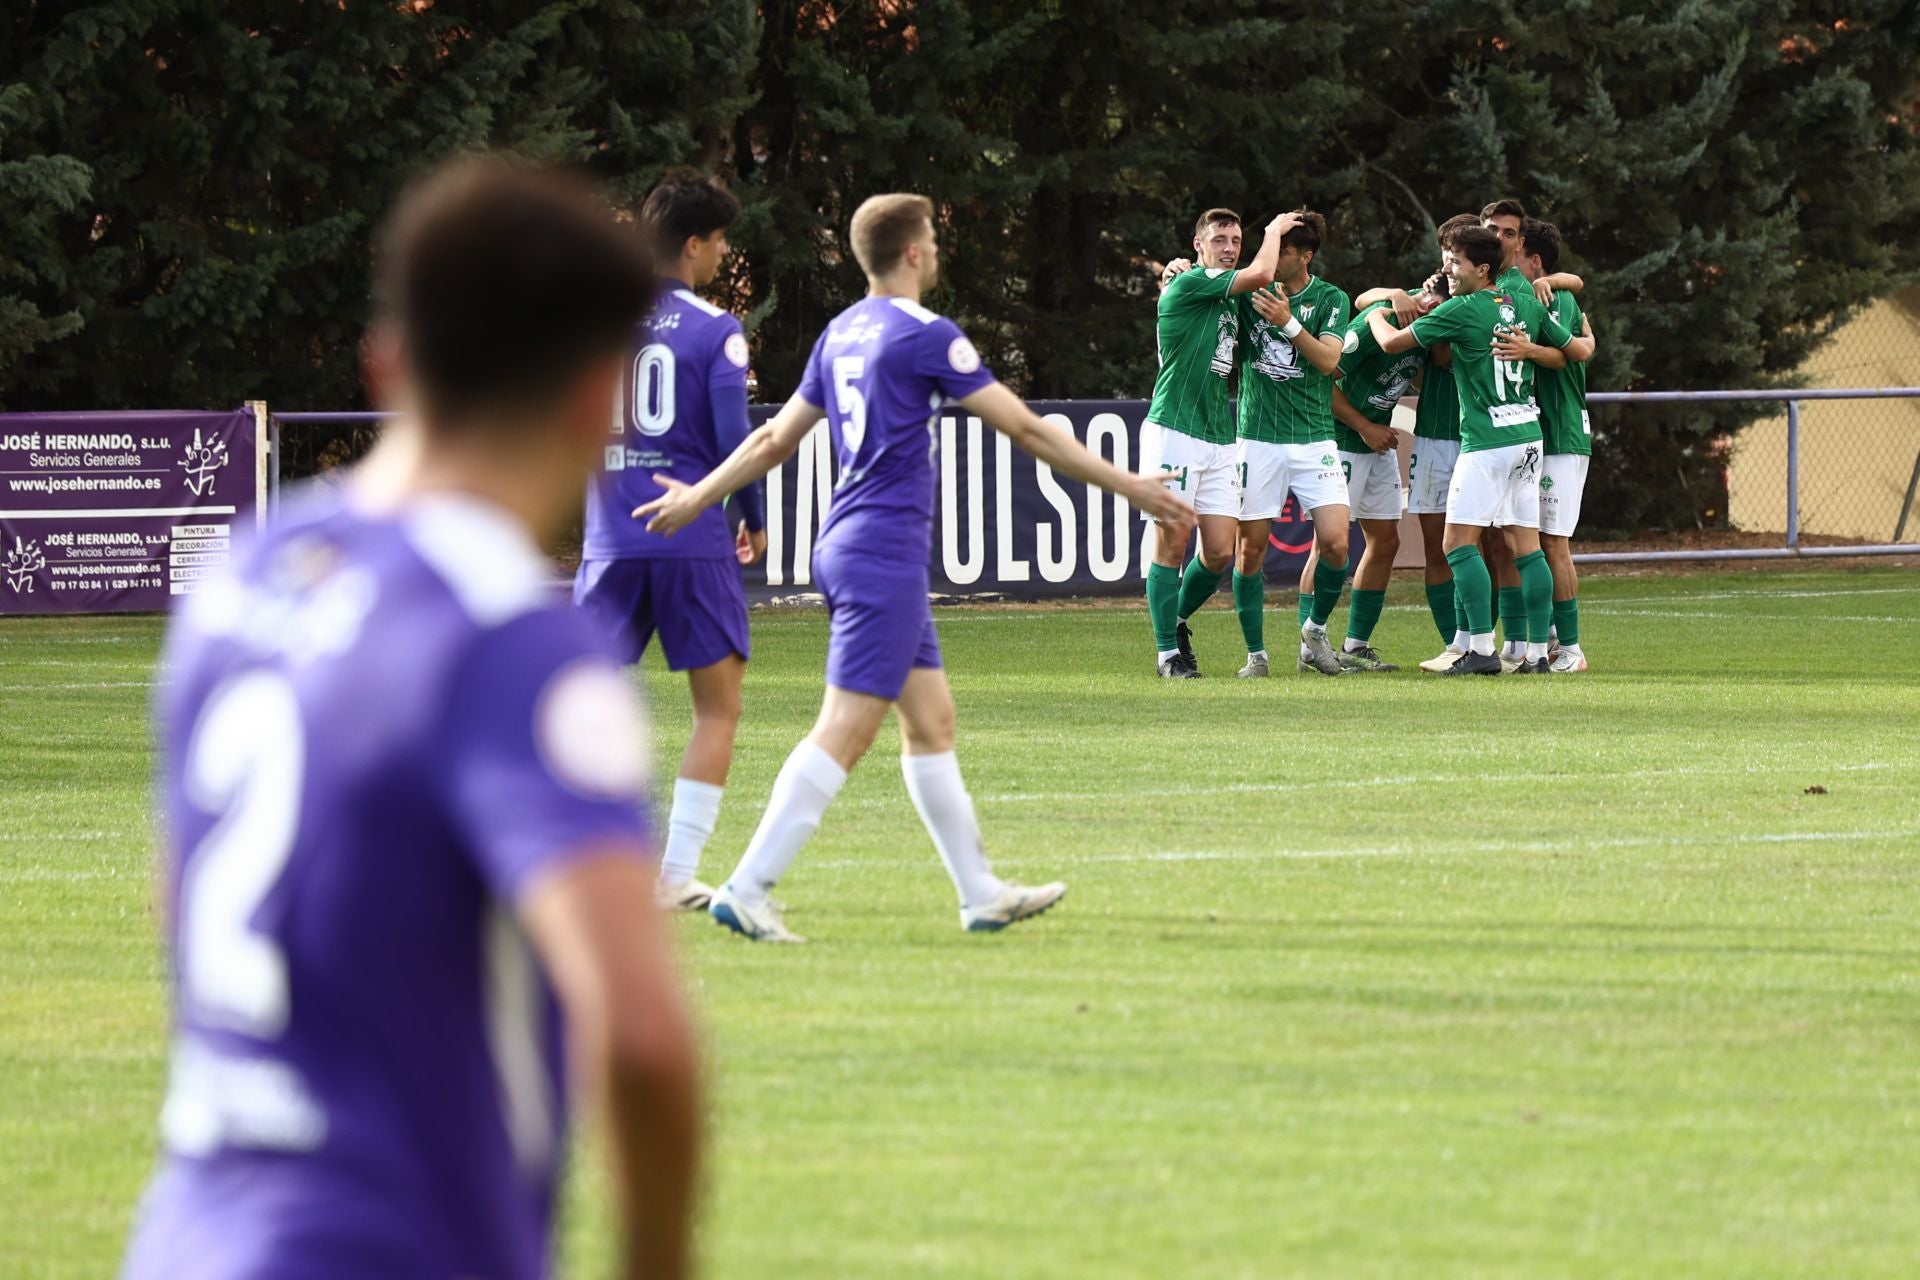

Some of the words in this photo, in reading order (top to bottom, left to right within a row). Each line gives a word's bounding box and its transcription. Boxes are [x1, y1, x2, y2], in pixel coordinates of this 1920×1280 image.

[833, 356, 866, 453] 5
[0, 432, 41, 450] JOSÉ
[45, 434, 137, 452] HERNANDO,
[29, 452, 80, 467] Servicios
[84, 452, 141, 466] Generales
[9, 475, 161, 494] www.josehernando.es
[183, 527, 216, 535] PINTURA
[45, 532, 74, 546] JOSÉ
[77, 533, 143, 546] HERNANDO,
[176, 540, 224, 550] DECORACIÓN
[66, 547, 102, 558] Servicios
[104, 546, 147, 557] Generales
[51, 563, 161, 577] www.josehernando.es
[68, 581, 77, 590] 17
[79, 580, 89, 589] 03
[112, 579, 128, 589] 629
[140, 578, 150, 588] 71
[152, 578, 162, 588] 19
[183, 666, 306, 1040] 2
